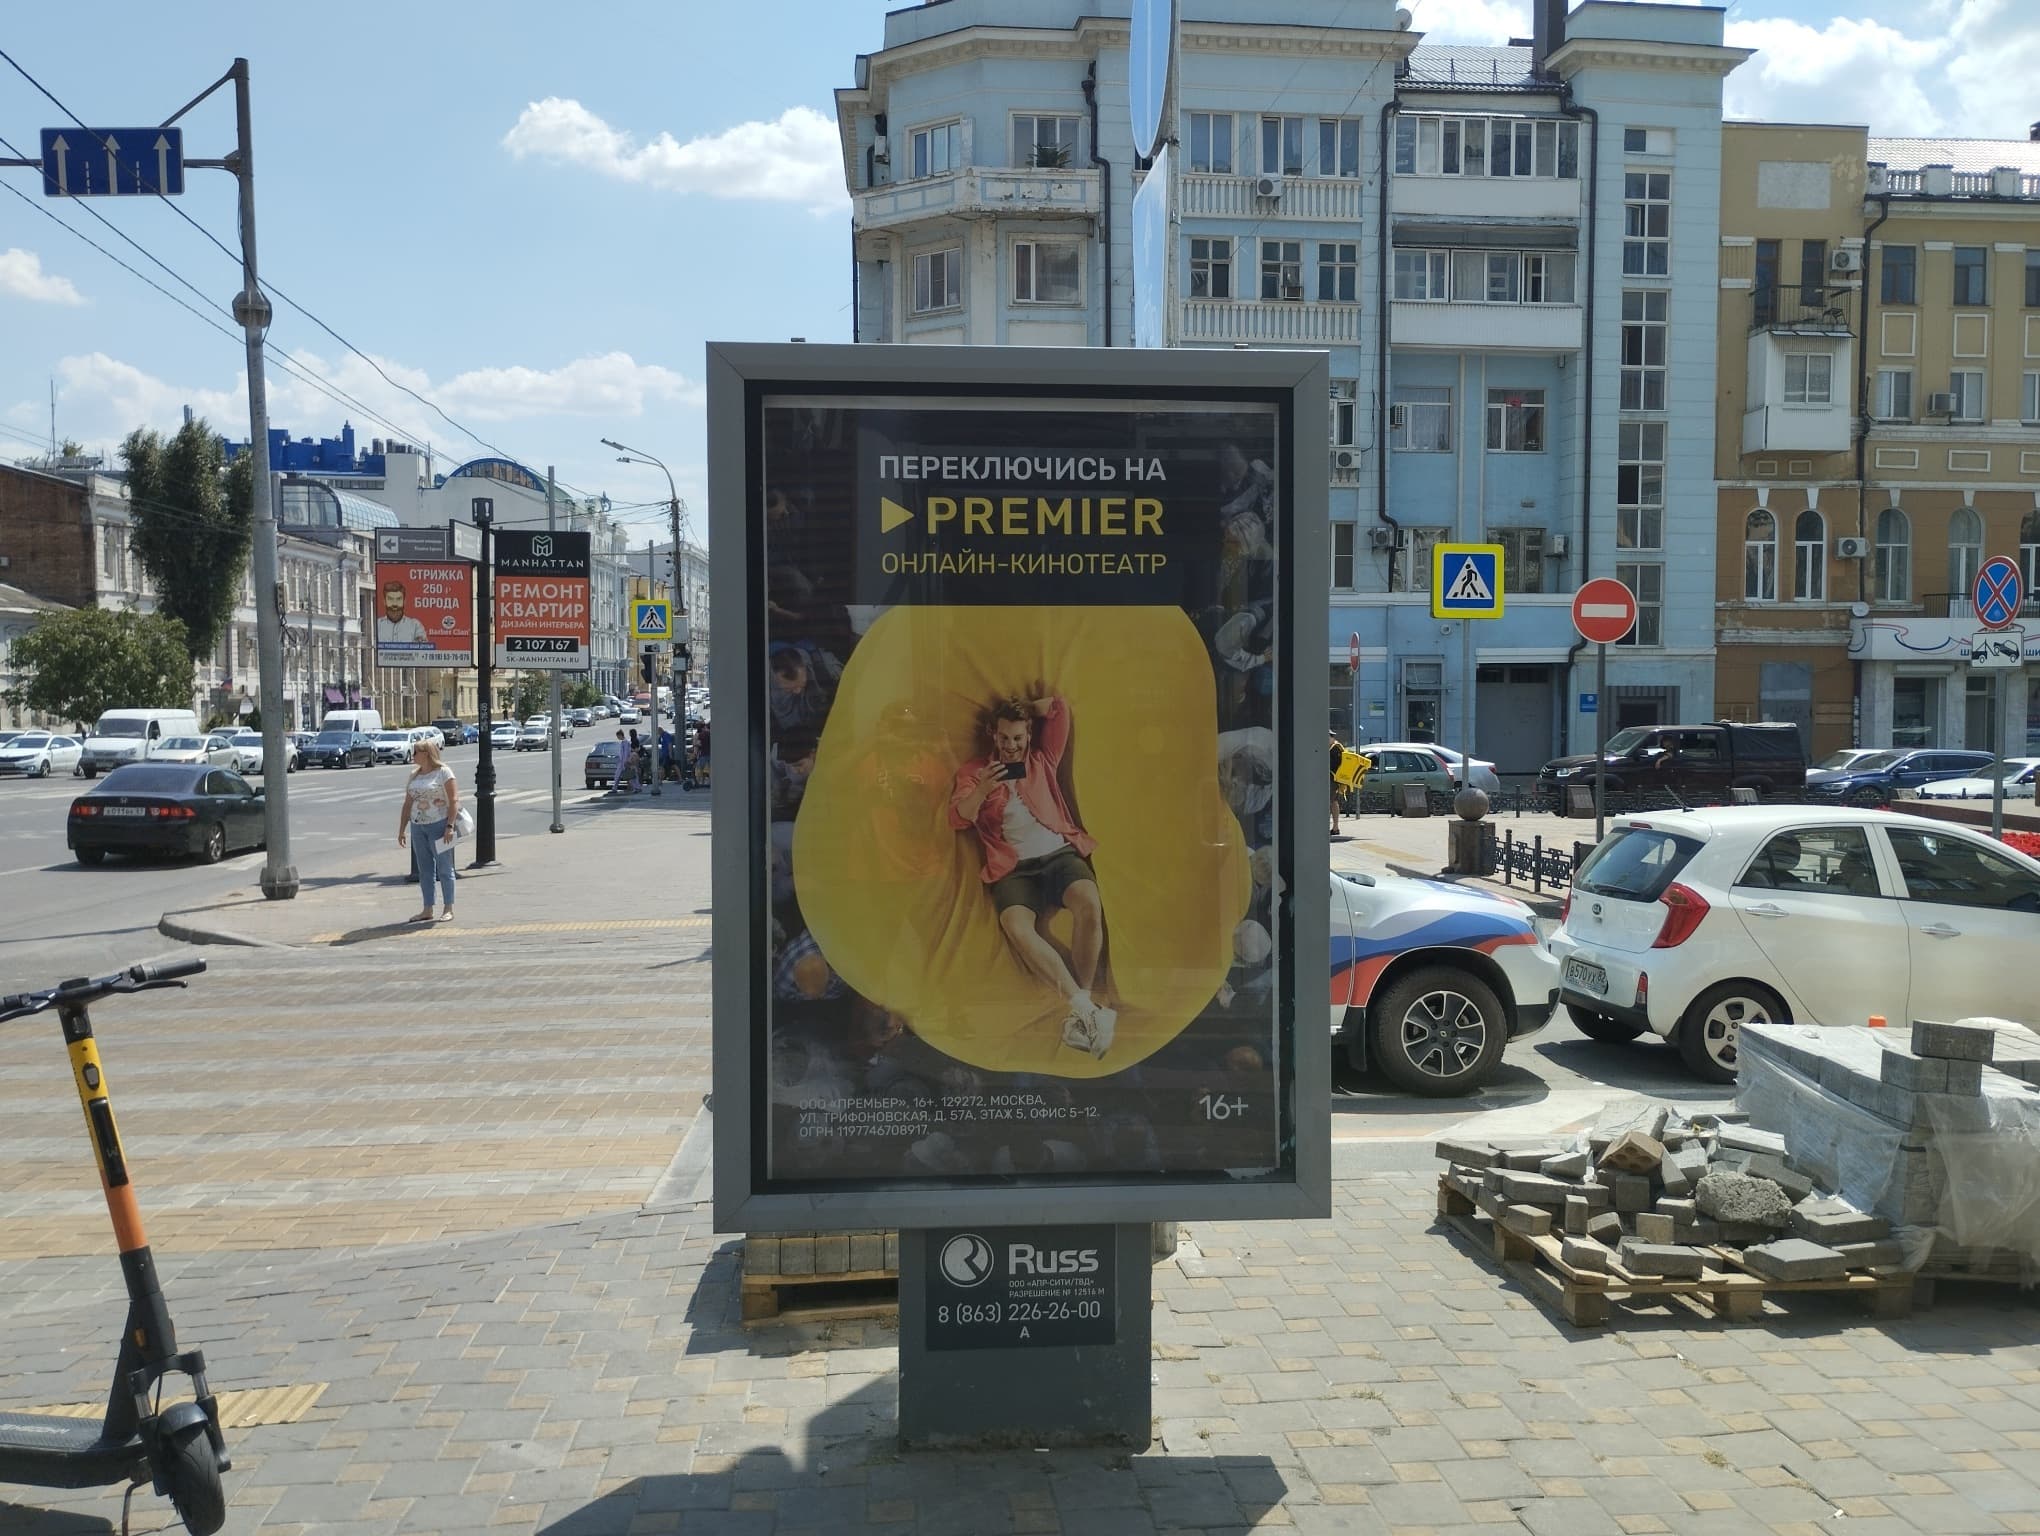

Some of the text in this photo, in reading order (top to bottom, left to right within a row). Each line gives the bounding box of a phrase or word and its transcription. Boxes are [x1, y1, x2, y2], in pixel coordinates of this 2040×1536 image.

[880, 455, 1167, 481] ПЕРЕКЛЮЧИСЬ НА
[927, 497, 1164, 535] PREMIER
[501, 559, 585, 569] MANHATTAN
[881, 548, 1168, 575] ОНЛАЙН-КИНОТЕАТР
[409, 568, 465, 582] СТРИЖКА
[500, 583, 585, 600] РЕМОНТ
[414, 596, 461, 610] БОРОДА
[500, 602, 585, 619] КВАРТИР
[501, 619, 585, 631] ДИЗАЙН ИНТЕРЬЕРА
[514, 639, 571, 652] 2 107 167
[505, 655, 581, 664] SK-MANHATTAN.RU
[989, 1094, 1047, 1107] МОСКВА,
[1199, 1094, 1248, 1120] 16+
[979, 1108, 1013, 1120] ЭТАЖ
[1029, 1106, 1067, 1120] ОФИС
[799, 1126, 835, 1138] ОГРН
[1008, 1243, 1100, 1275] Russ
[1008, 1280, 1026, 1288] ООО
[1008, 1289, 1062, 1299] РАЗРЕШЕНИЕ
[938, 1300, 1101, 1325] 8 (863) 226-26-00
